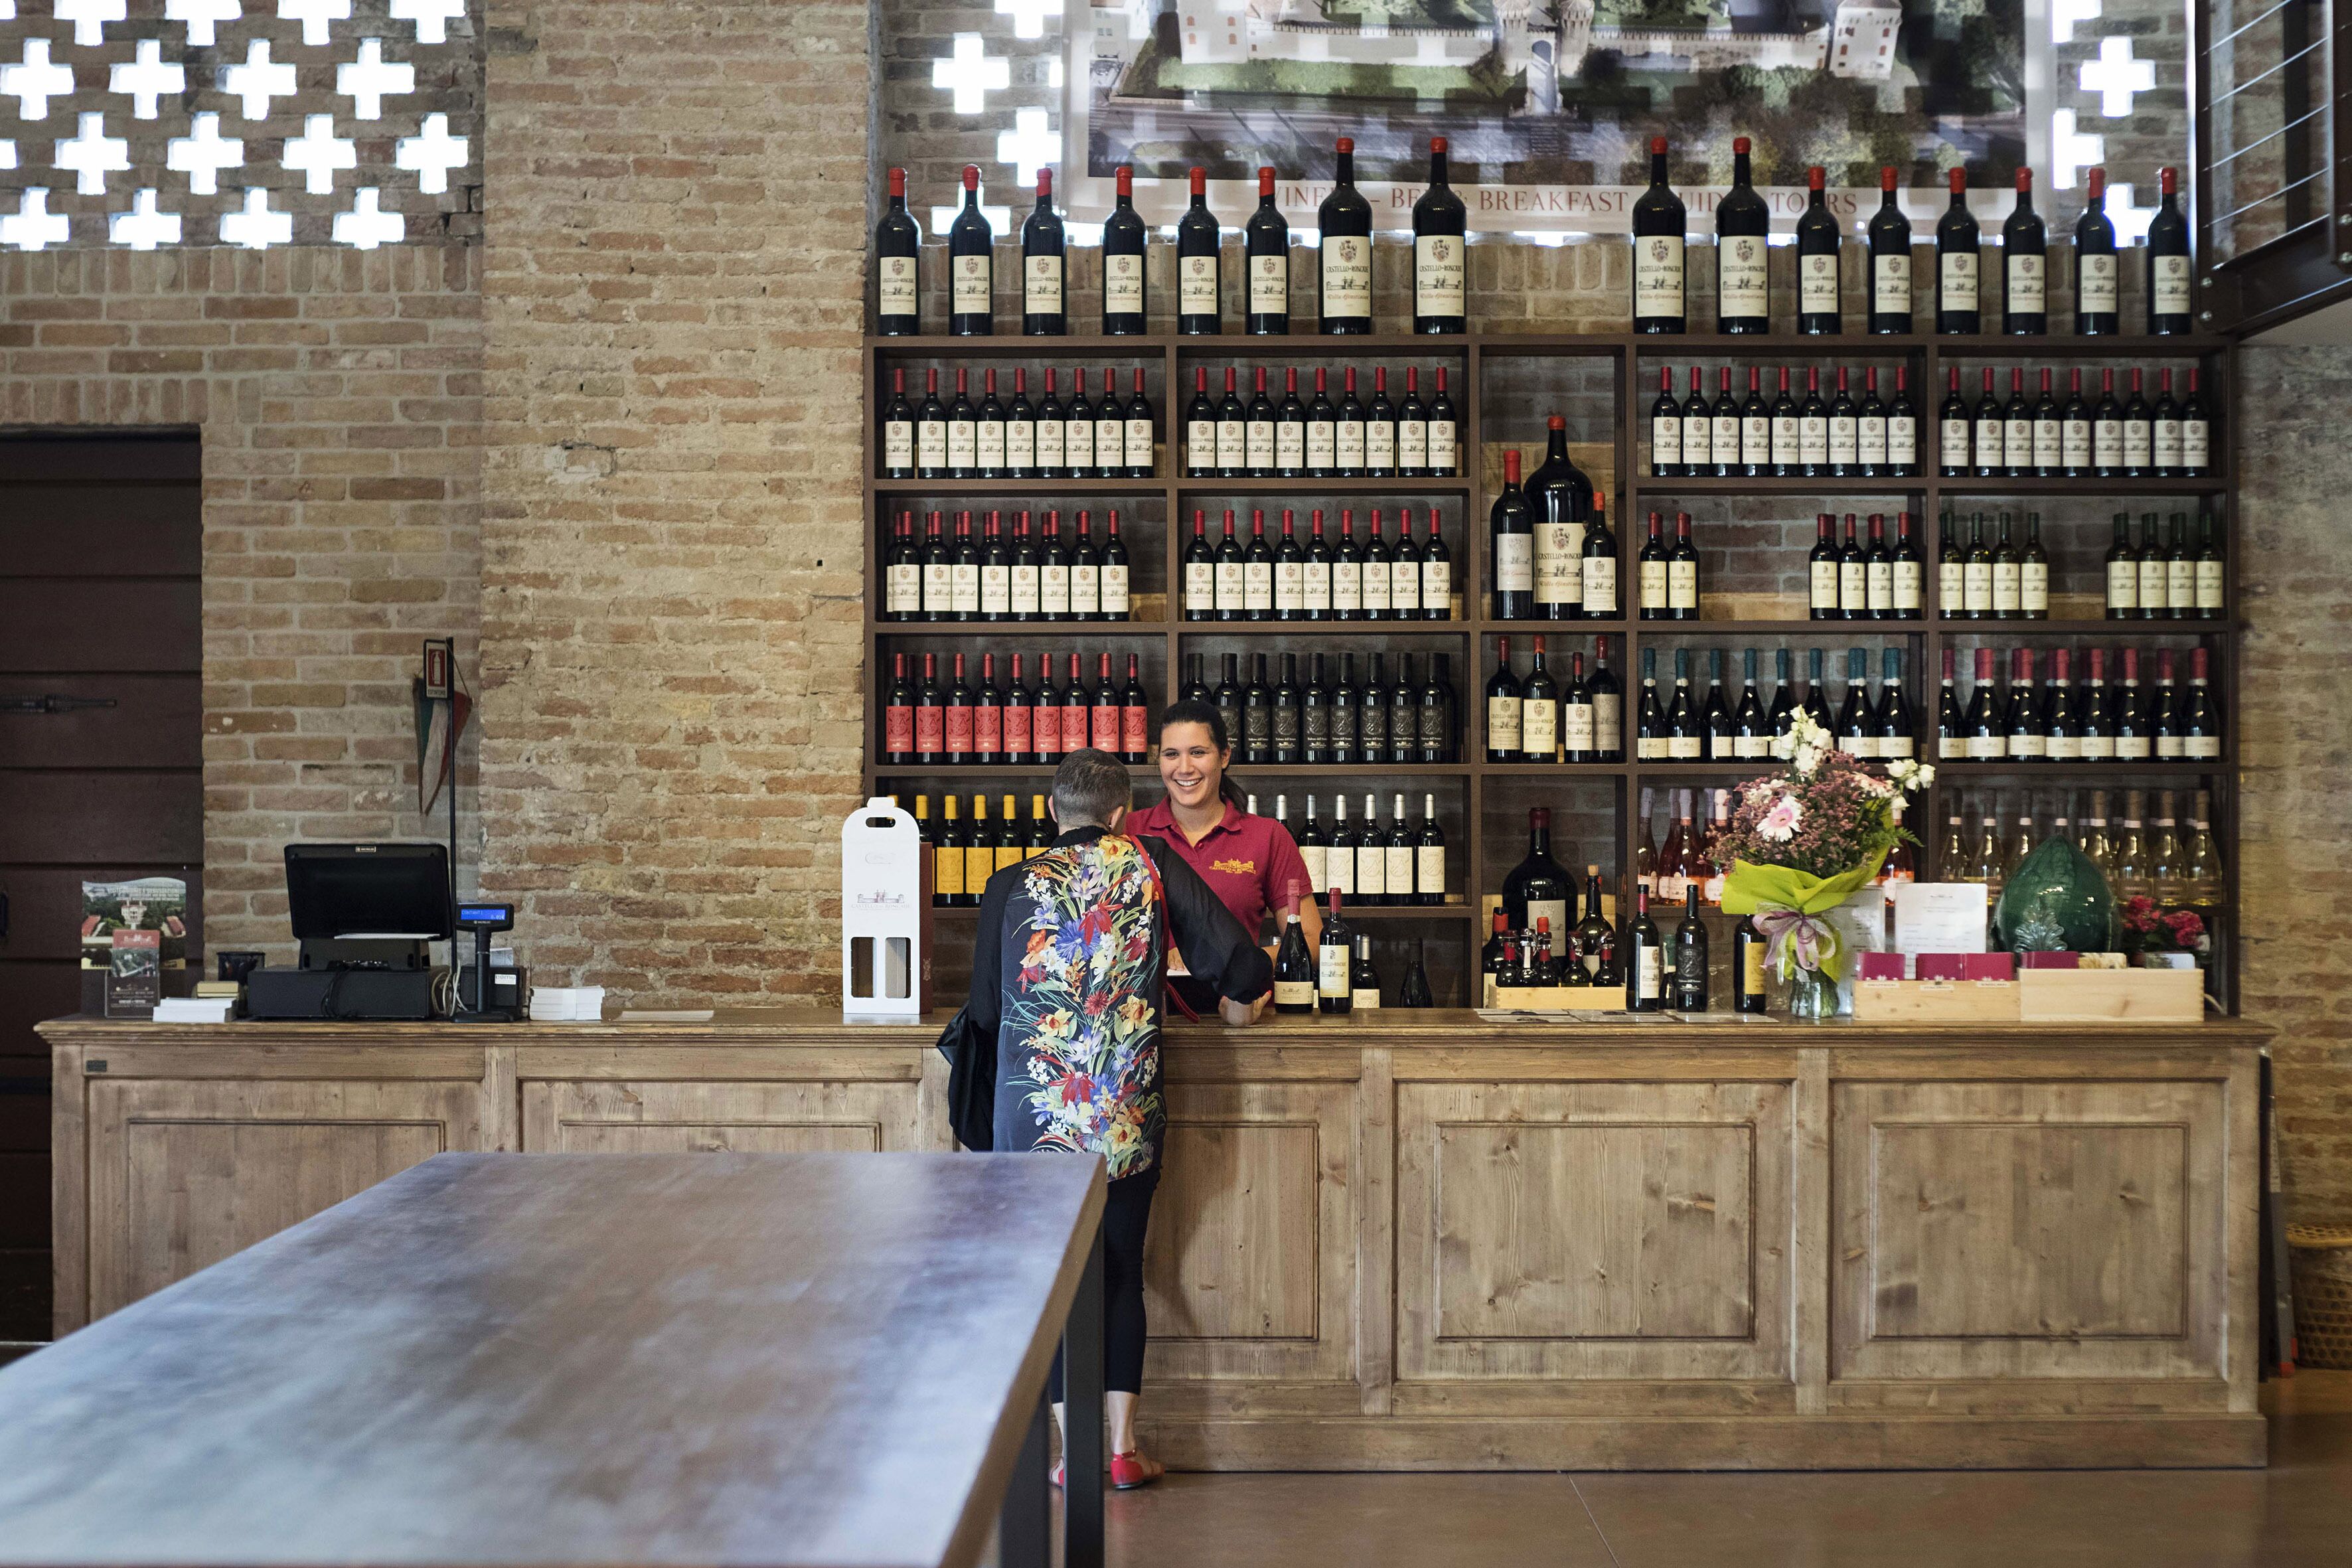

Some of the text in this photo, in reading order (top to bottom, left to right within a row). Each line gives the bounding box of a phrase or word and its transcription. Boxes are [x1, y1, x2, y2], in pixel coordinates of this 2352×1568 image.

[1391, 188, 1428, 208] BE
[1480, 191, 1628, 212] BREAKFAST
[1771, 193, 1857, 214] TORS
